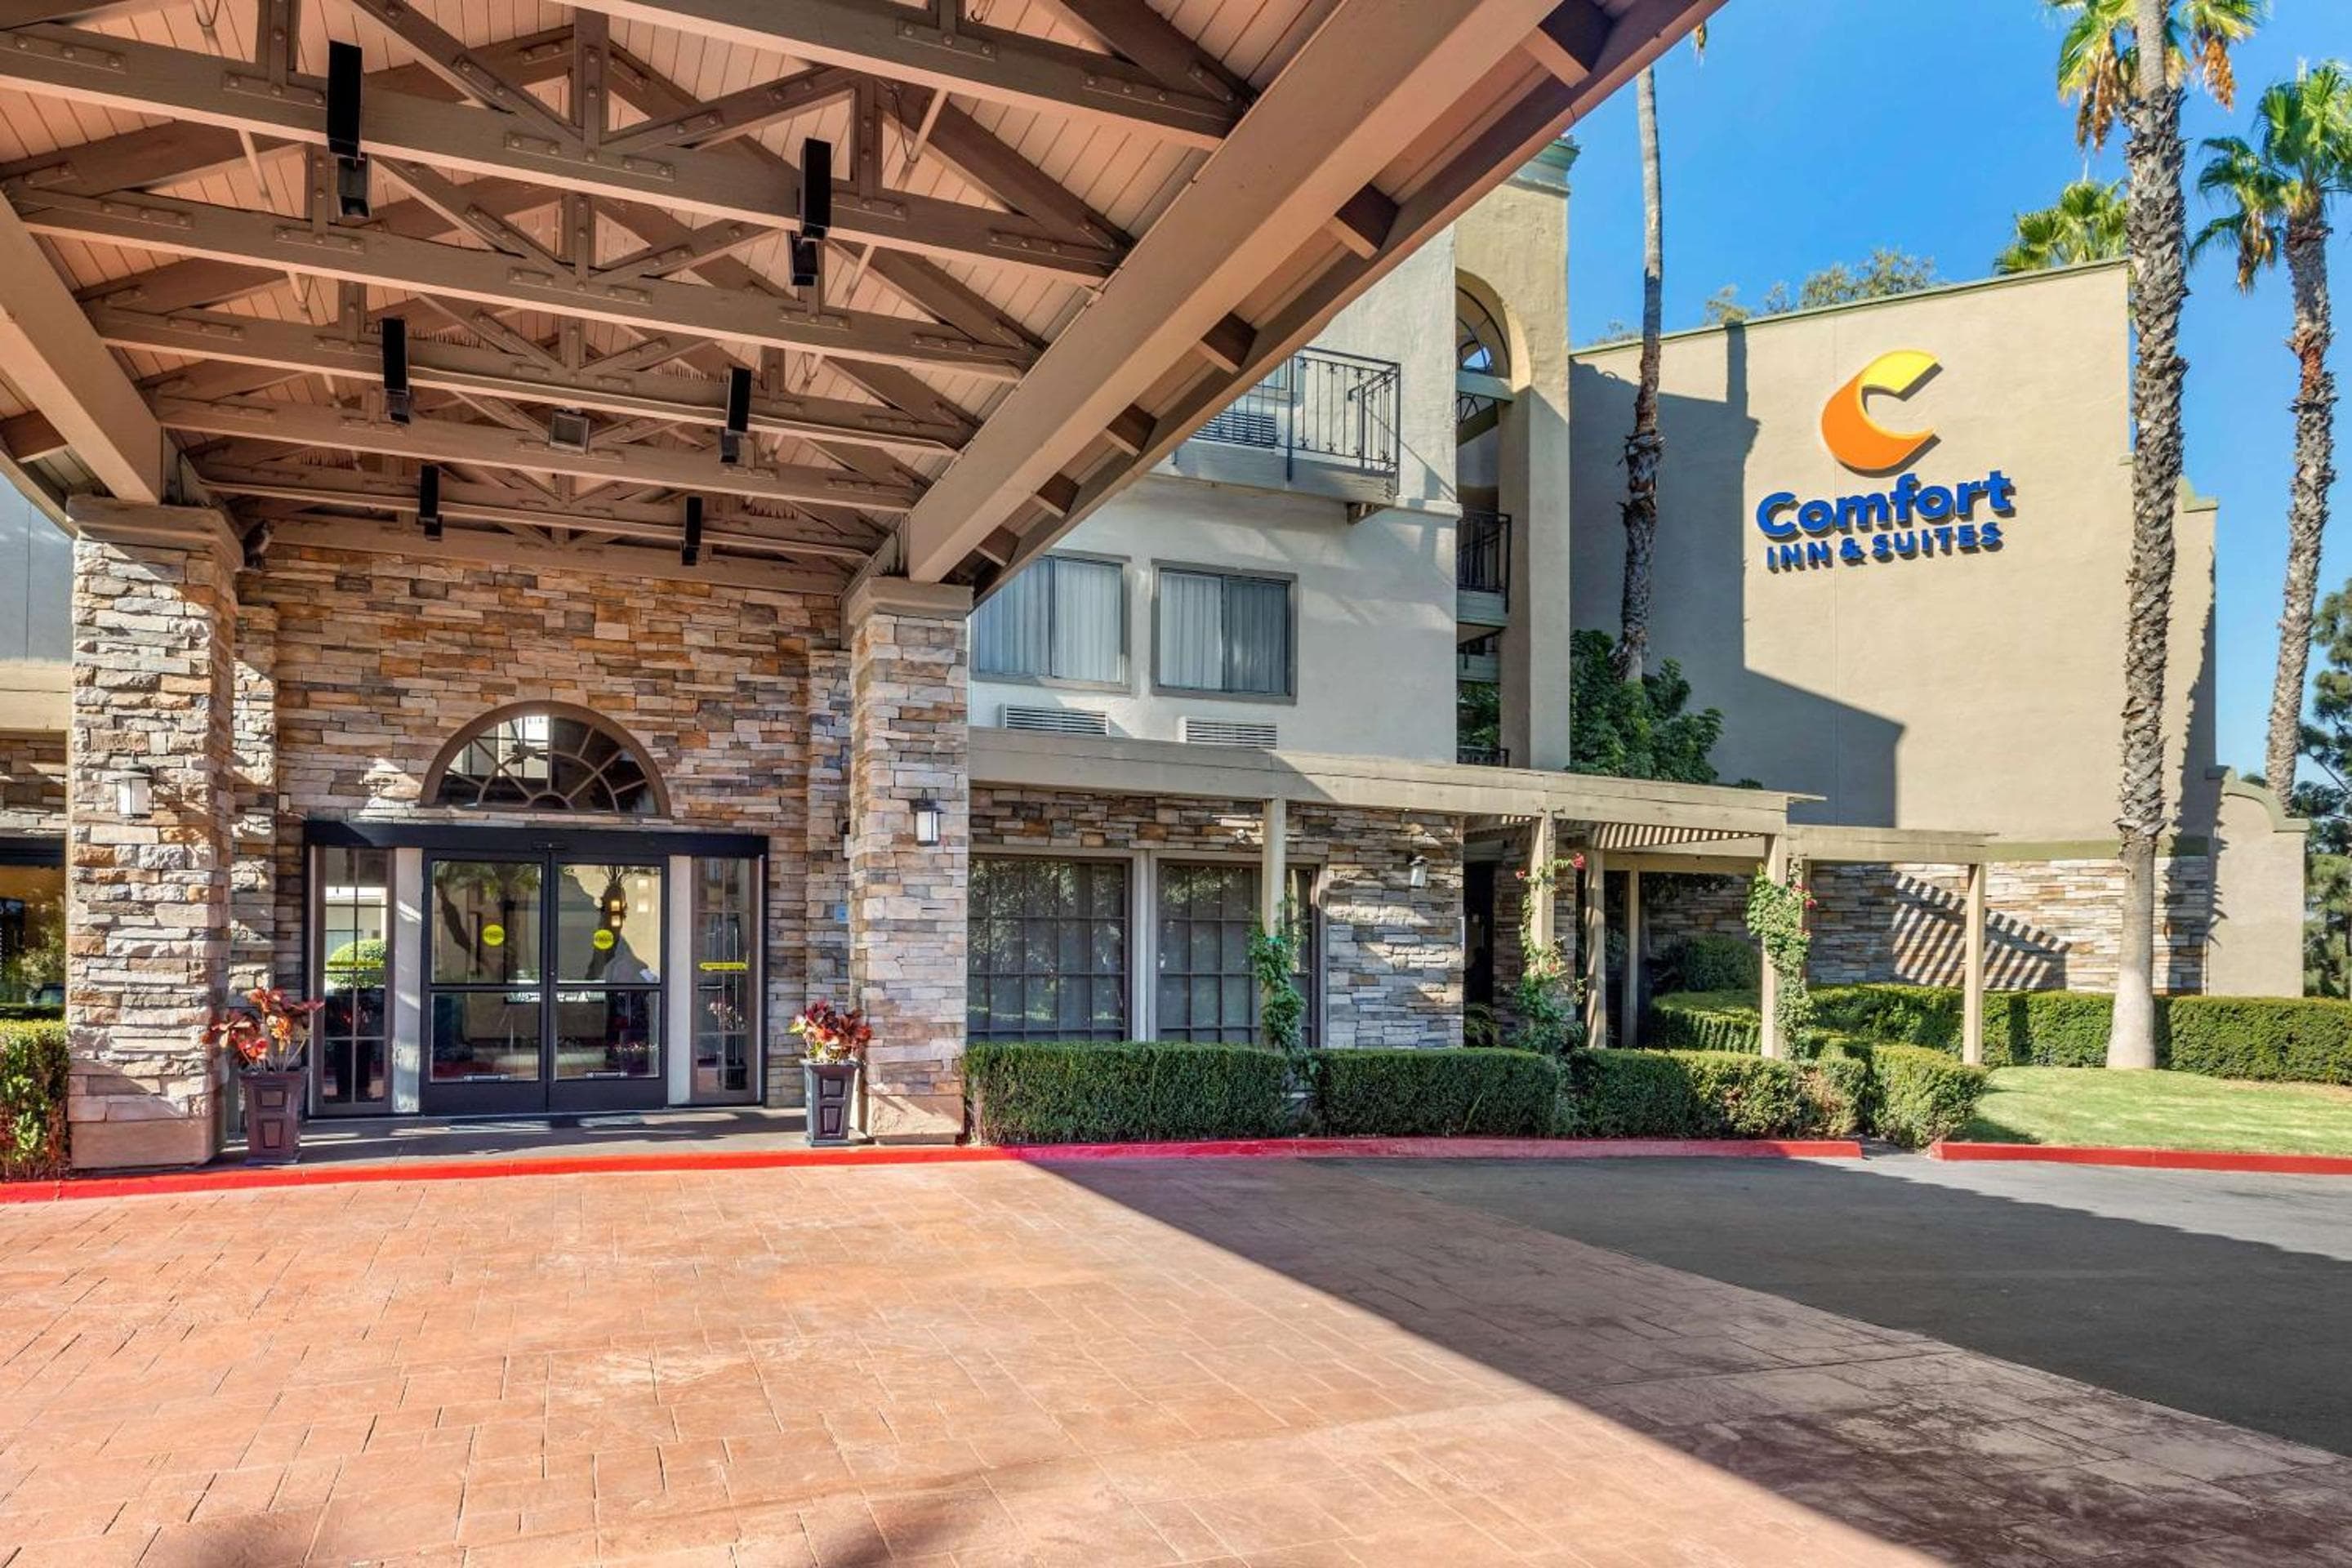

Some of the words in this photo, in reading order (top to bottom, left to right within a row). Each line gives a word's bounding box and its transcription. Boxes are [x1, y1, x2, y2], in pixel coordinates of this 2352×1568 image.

[1757, 470, 2011, 537] Comfort
[1766, 541, 1829, 570] INN
[1839, 537, 1864, 560] &
[1872, 521, 2002, 558] SUITES
